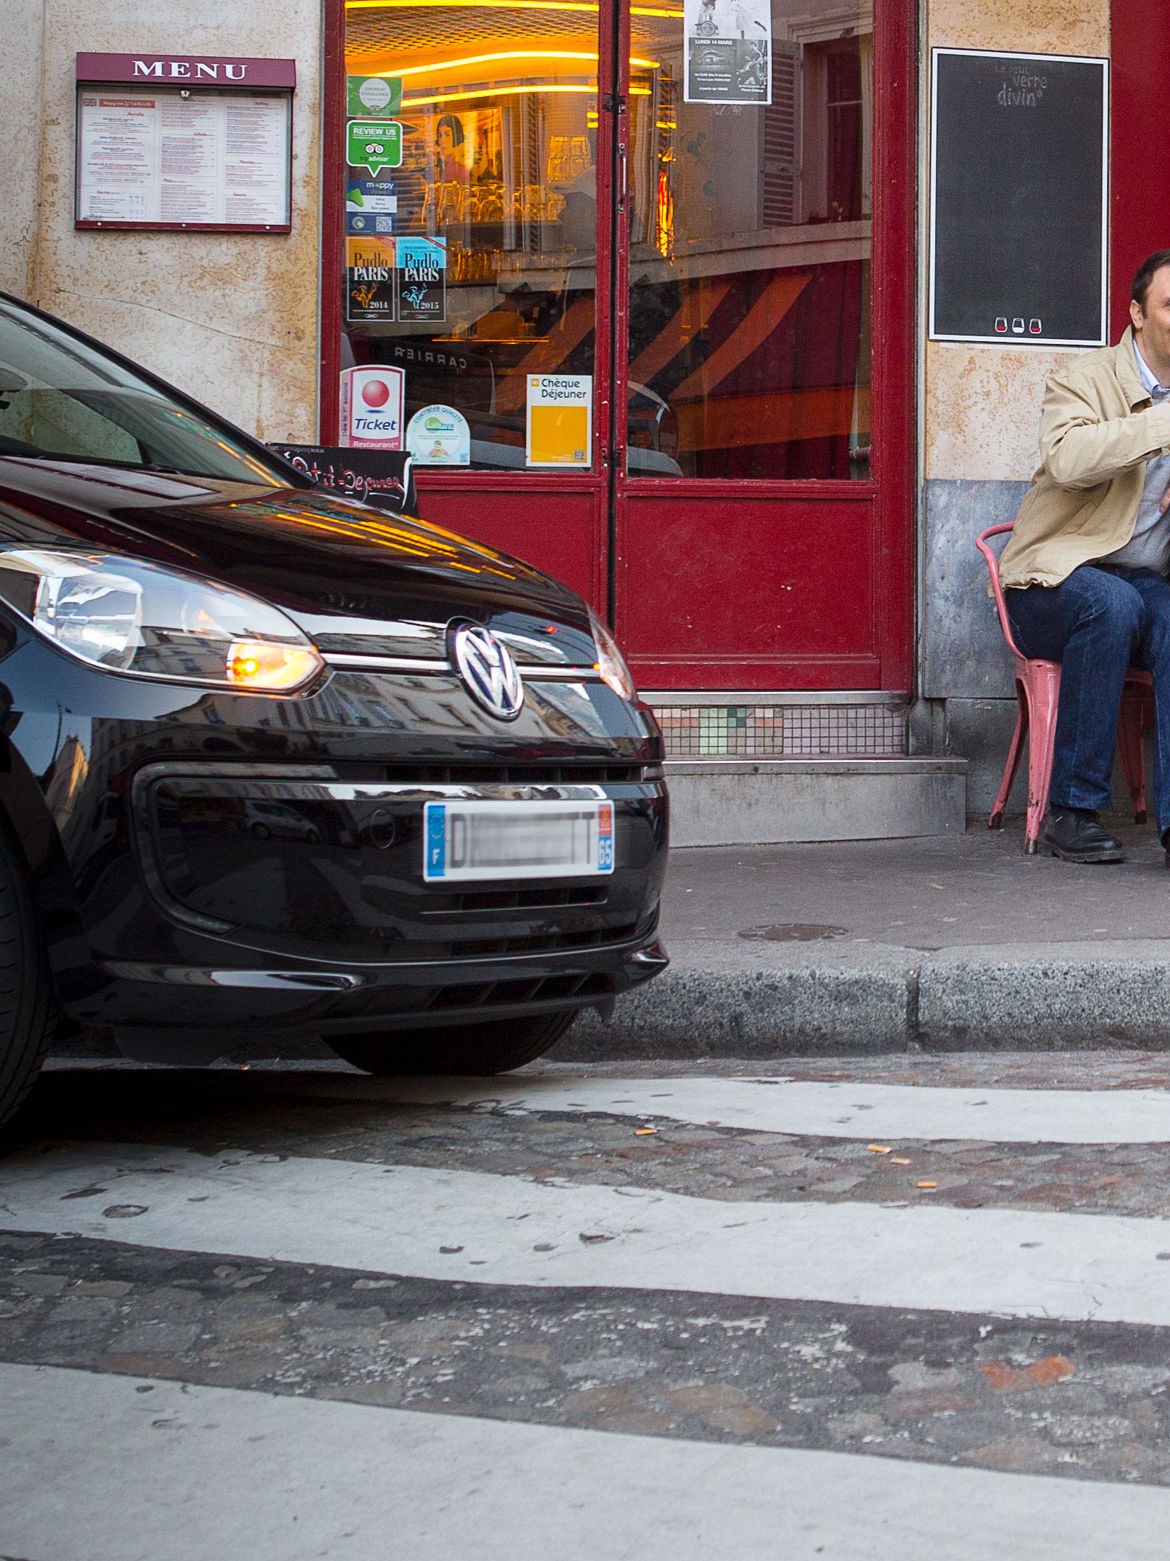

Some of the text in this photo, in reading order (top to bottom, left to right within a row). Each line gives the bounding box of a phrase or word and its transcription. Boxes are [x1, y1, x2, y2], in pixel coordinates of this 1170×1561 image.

[132, 60, 249, 80] MENU
[1012, 75, 1049, 89] verre
[353, 127, 397, 136] REVIEW US
[353, 252, 388, 268] Pudlo
[404, 252, 439, 268] Pudlo
[354, 267, 389, 281] PARIS
[404, 268, 439, 282] PARIS
[369, 301, 388, 309] 2014
[420, 301, 440, 310] 2015
[541, 377, 581, 389] Chèque
[541, 388, 587, 400] Déjeuner
[354, 418, 397, 431] Ticket
[432, 848, 440, 865] F
[599, 839, 613, 865] 65
